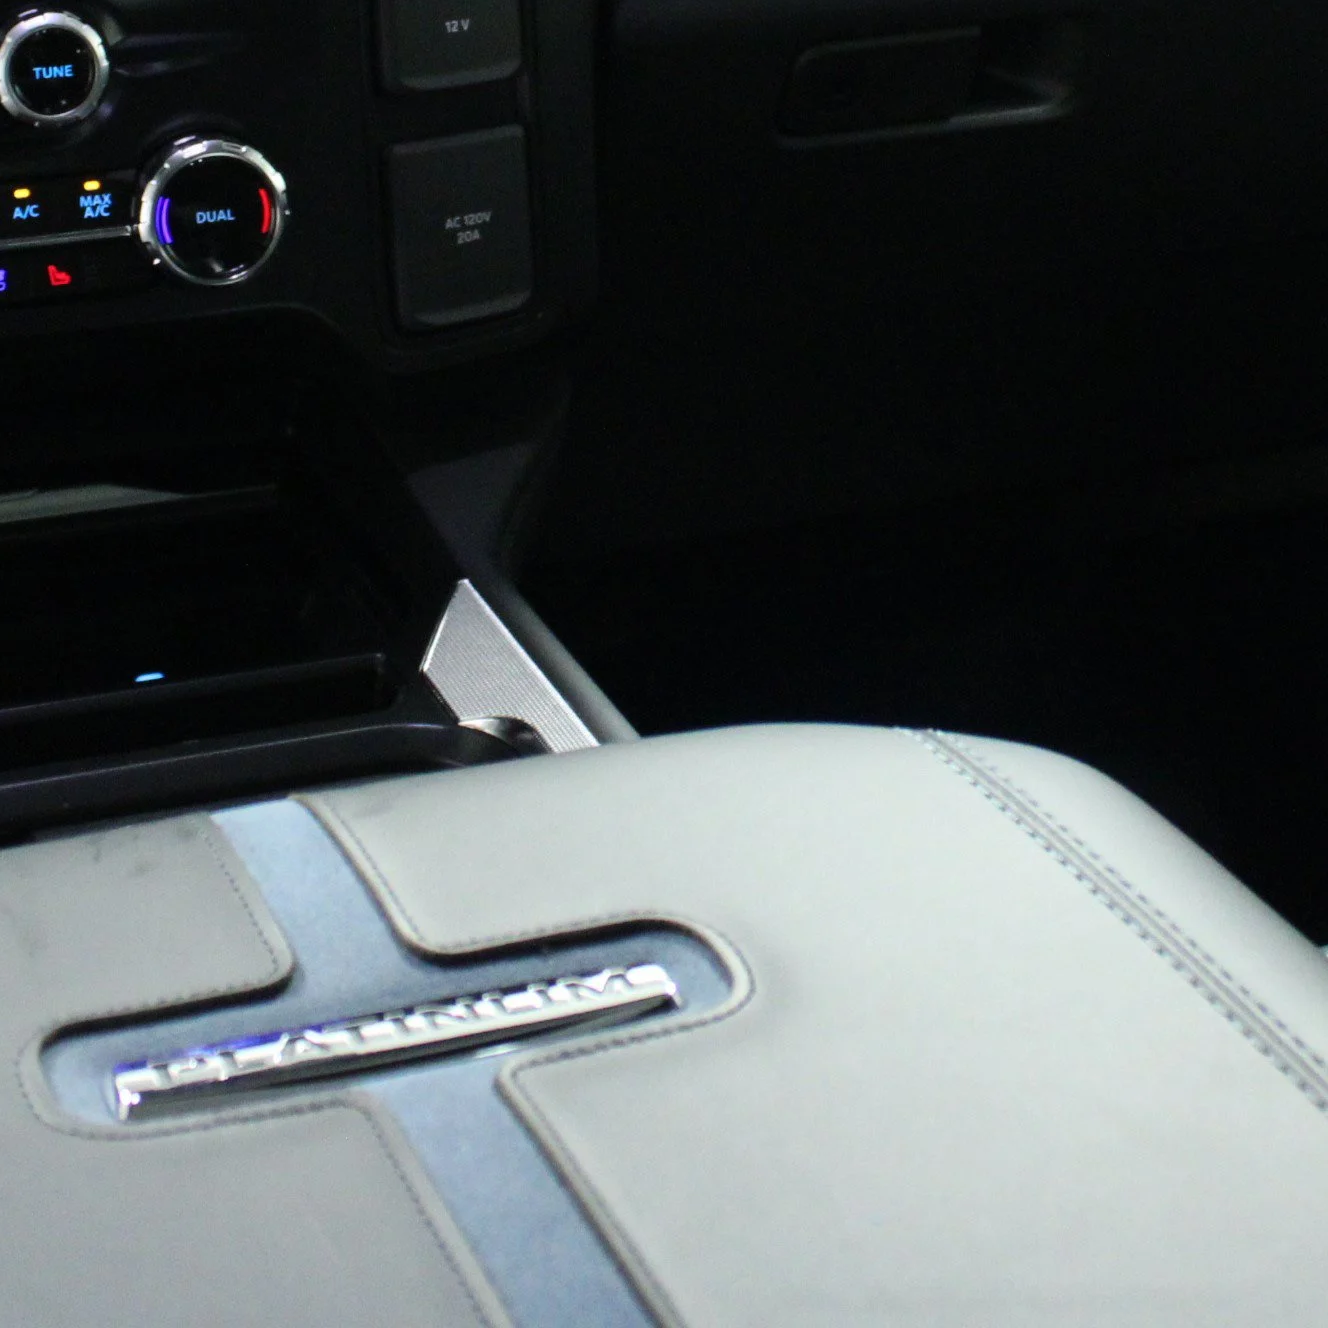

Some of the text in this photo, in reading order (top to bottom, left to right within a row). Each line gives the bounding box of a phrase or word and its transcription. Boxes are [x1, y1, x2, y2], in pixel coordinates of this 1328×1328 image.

[445, 20, 459, 33] 12
[33, 65, 74, 80] TUNE
[80, 193, 112, 207] MAX
[13, 203, 40, 220] A/C
[83, 204, 111, 219] A/C
[196, 208, 235, 224] DUAL
